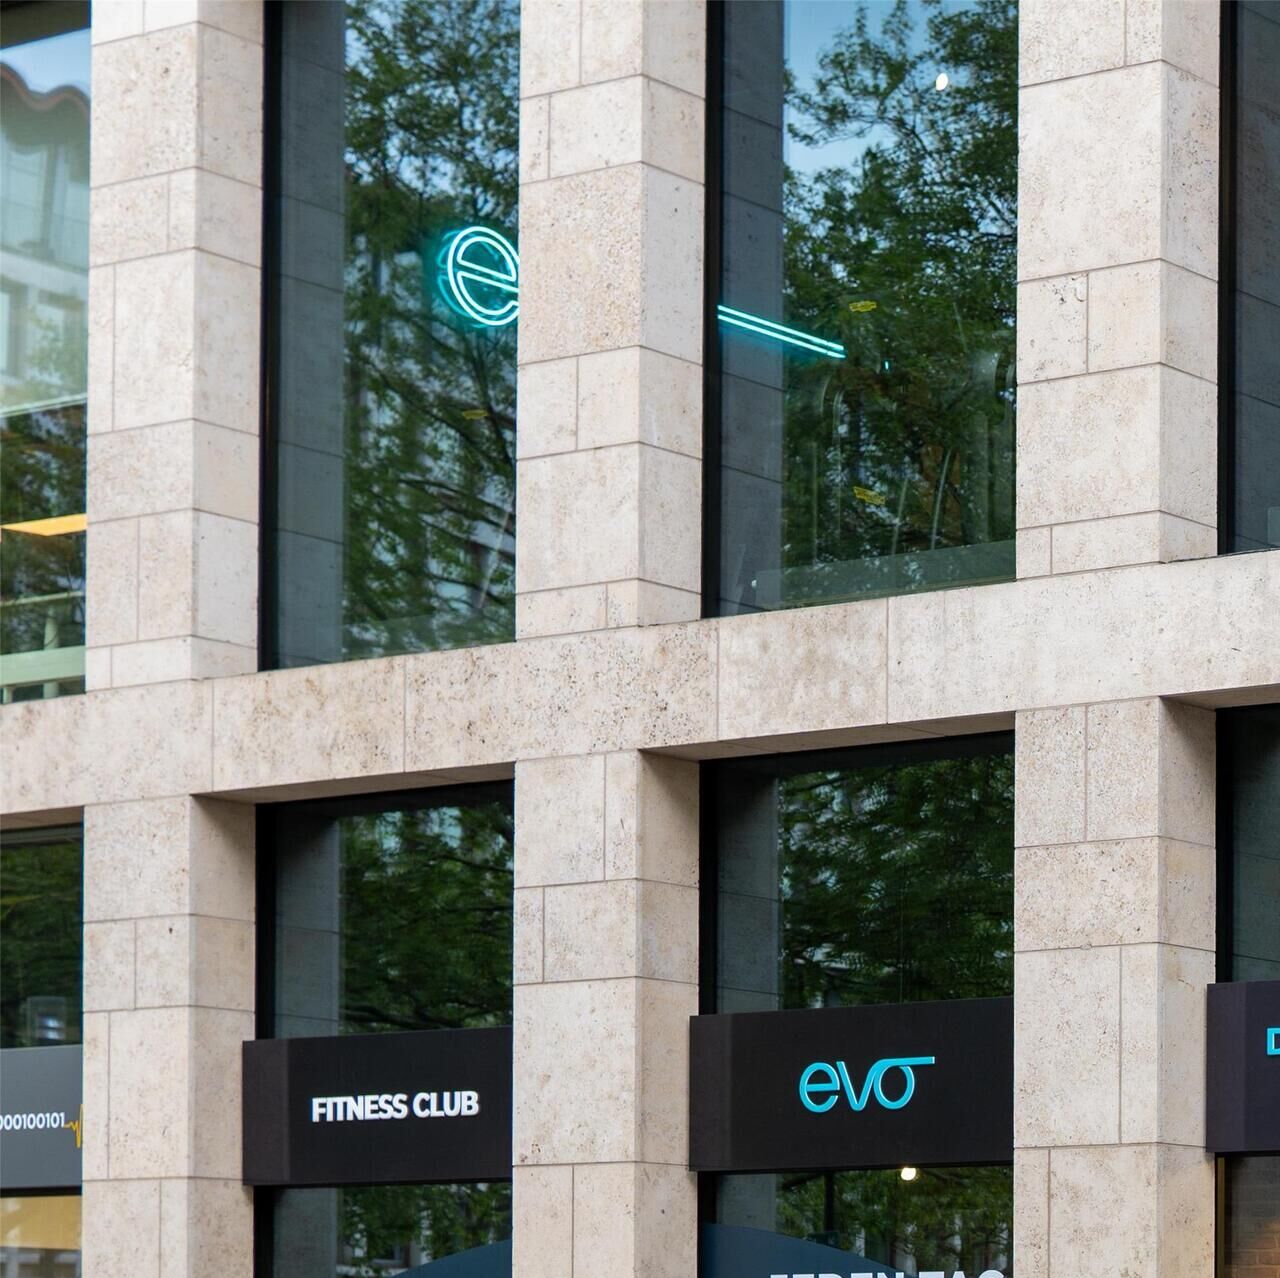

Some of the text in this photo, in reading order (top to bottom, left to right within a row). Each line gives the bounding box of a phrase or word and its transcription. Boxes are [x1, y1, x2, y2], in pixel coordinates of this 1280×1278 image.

[800, 1056, 935, 1113] evo
[0, 1112, 65, 1130] 00100101
[312, 1090, 480, 1123] FITNESS CLUB
